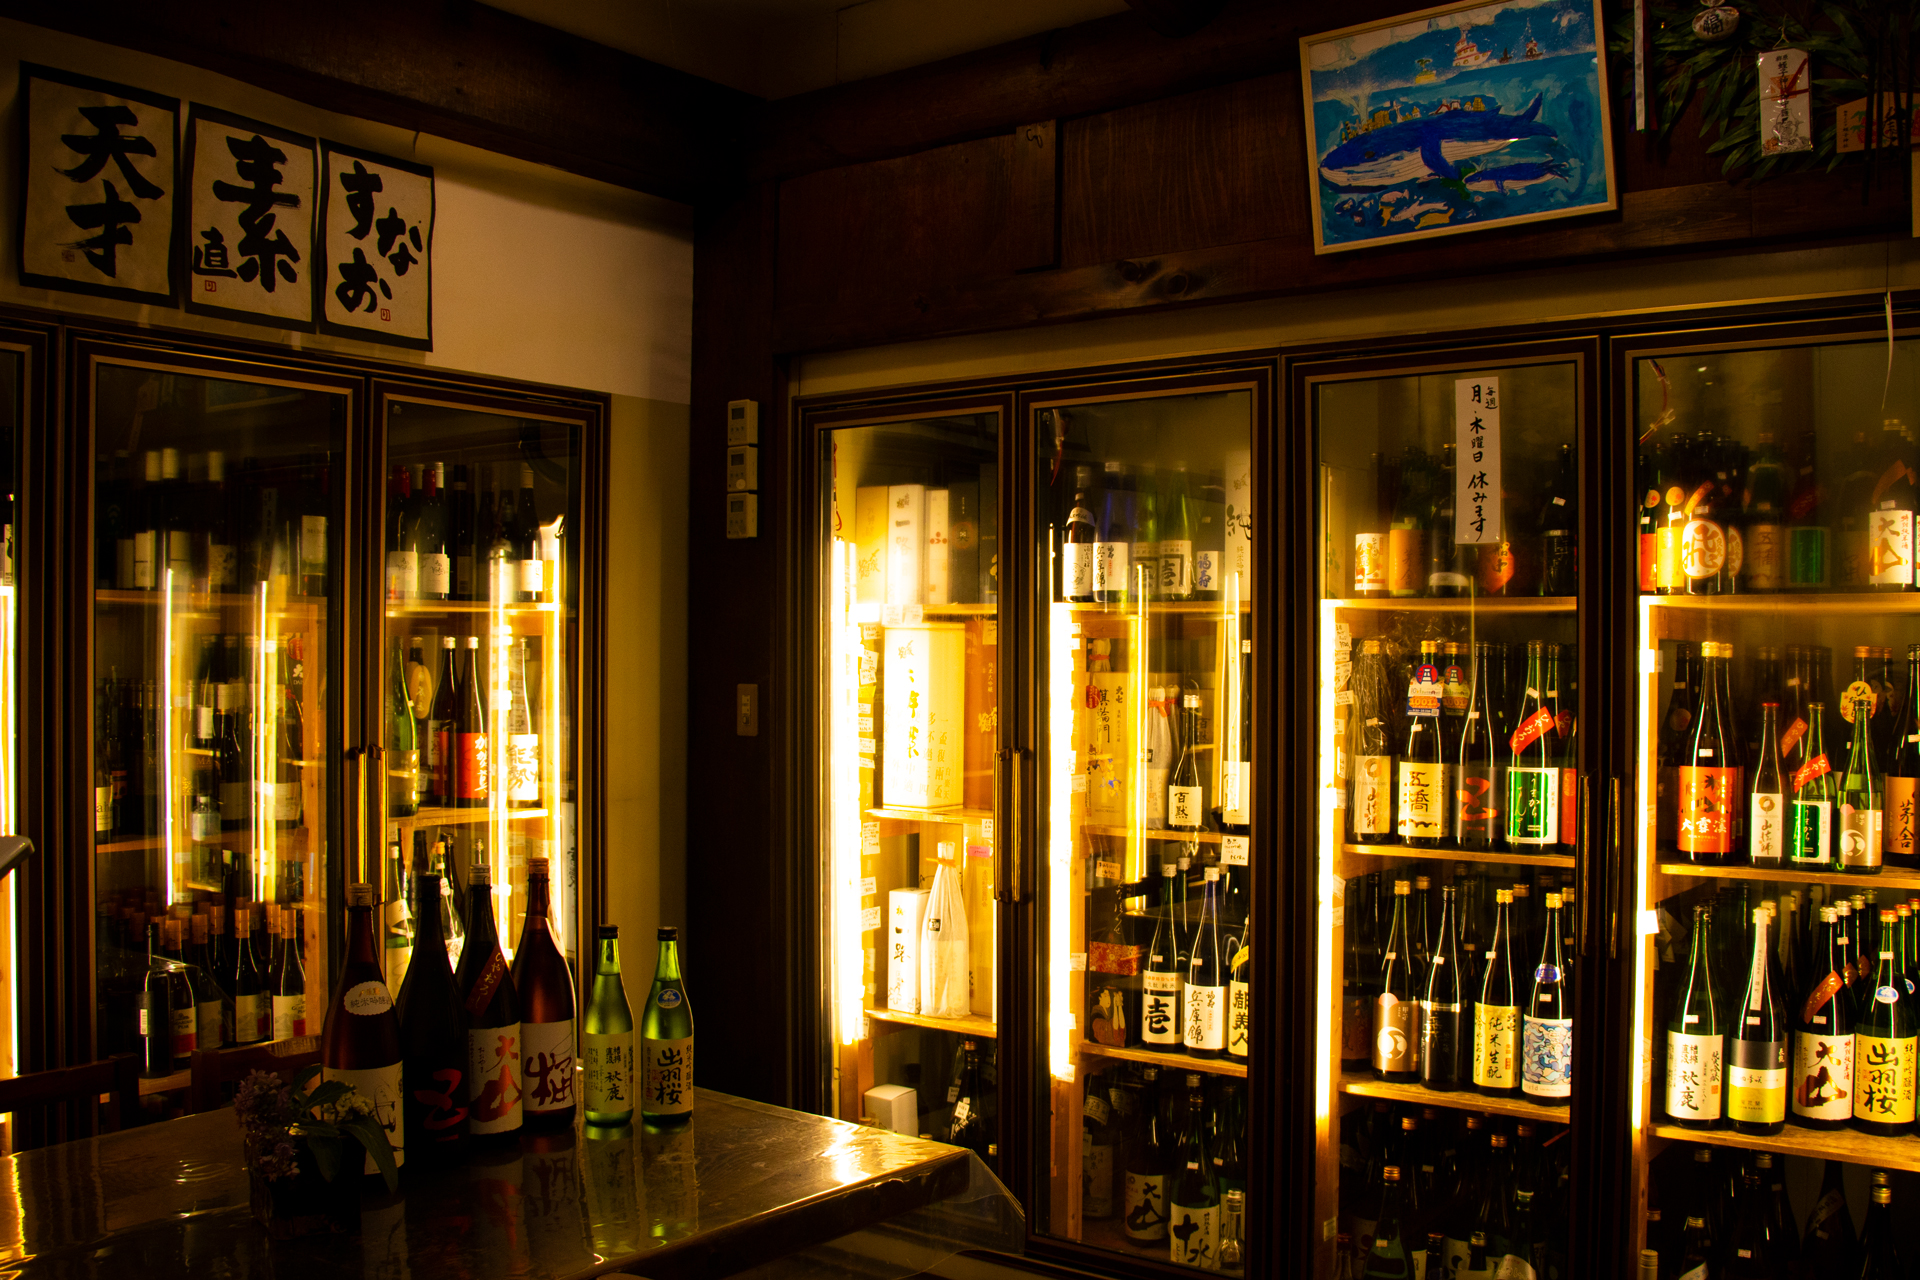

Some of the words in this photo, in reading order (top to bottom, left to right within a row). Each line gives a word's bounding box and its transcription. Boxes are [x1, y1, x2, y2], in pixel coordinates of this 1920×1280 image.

[1703, 14, 1724, 35] 福
[52, 105, 165, 278] 天才
[194, 134, 301, 293] 素直
[336, 160, 423, 313] すなお
[1485, 386, 1498, 410] 毎週
[1467, 470, 1489, 542] 休みます
[1198, 553, 1212, 587] 福寿
[1869, 517, 1908, 576] 大山
[1512, 712, 1551, 748] ひやおろし
[1408, 771, 1430, 813] 五橋
[472, 951, 506, 1010] ひやおろし
[1145, 997, 1171, 1035] 壱
[1187, 990, 1204, 1044] 兵庫錦
[655, 1047, 683, 1105] 出羽桜
[1487, 1017, 1504, 1078] 純米生酛
[1796, 1041, 1848, 1108] 大山
[470, 1035, 523, 1123] 大山
[604, 1070, 625, 1103] 秋鹿
[1679, 1070, 1699, 1111] 秋鹿
[1863, 1043, 1899, 1116] 出羽桜
[1127, 1182, 1167, 1231] 大山
